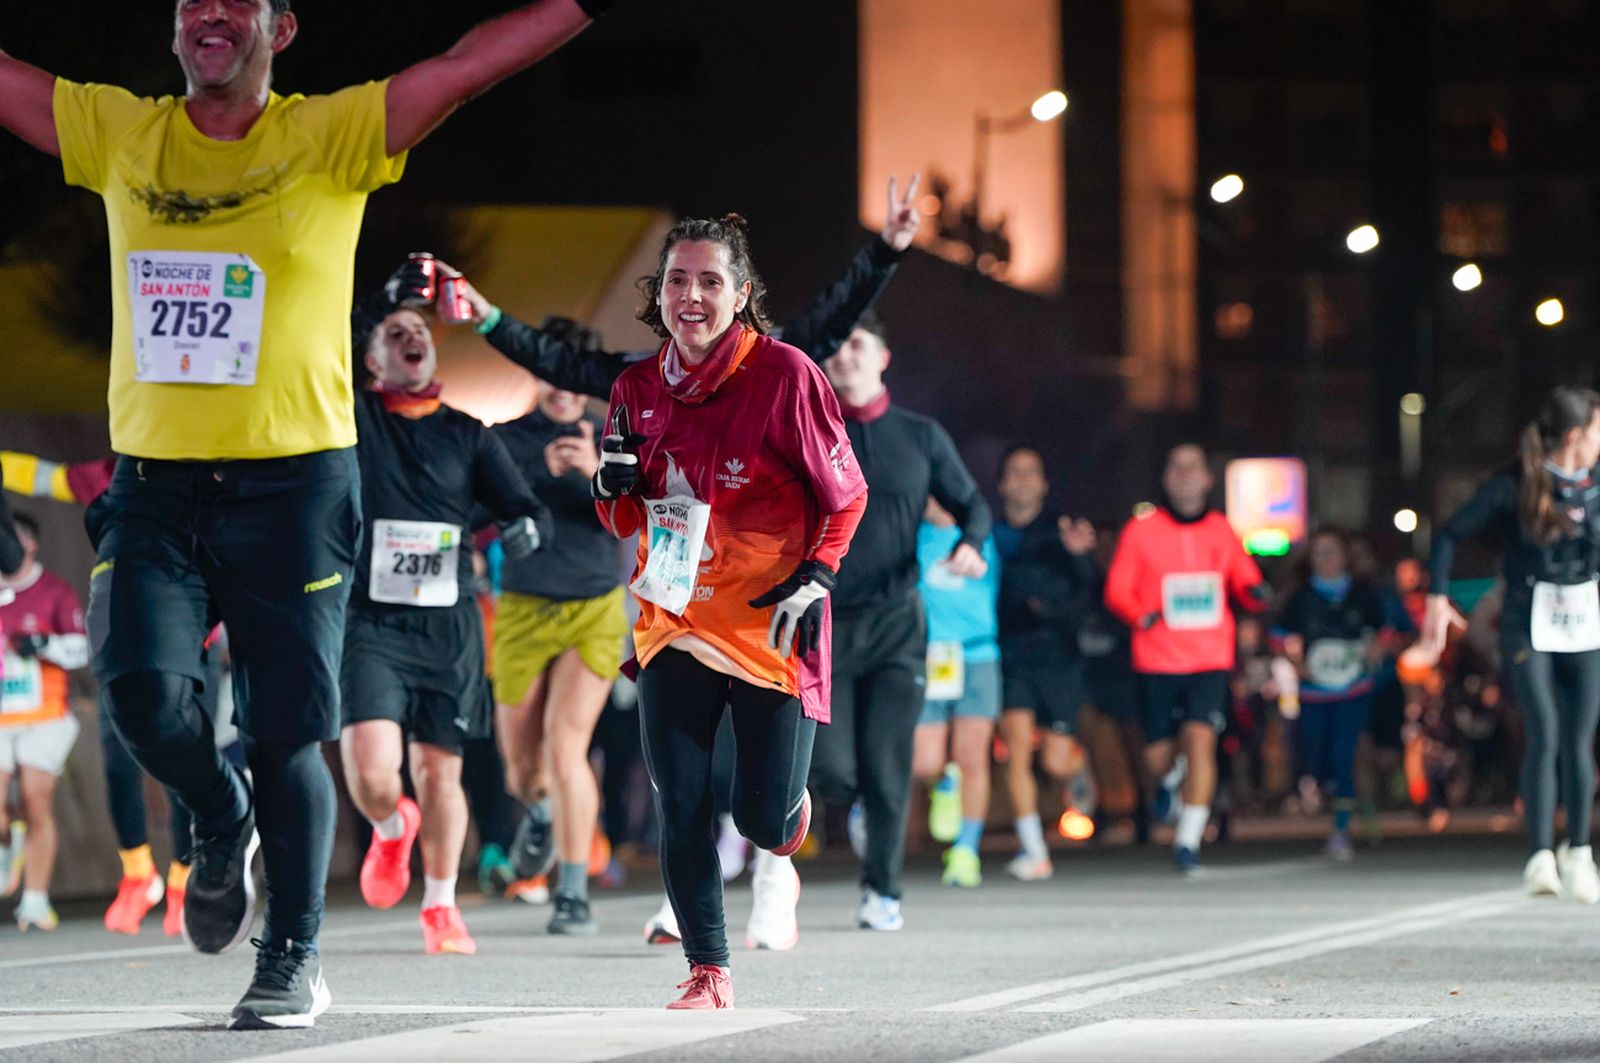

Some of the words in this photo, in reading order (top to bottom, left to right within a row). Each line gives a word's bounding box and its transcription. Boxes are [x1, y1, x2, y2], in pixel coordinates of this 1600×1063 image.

[154, 267, 193, 280] NOCHE
[196, 268, 212, 281] DE
[140, 282, 163, 297] SAN
[165, 280, 211, 298] ANTÓN
[151, 299, 232, 339] 2752
[393, 552, 443, 576] 2376
